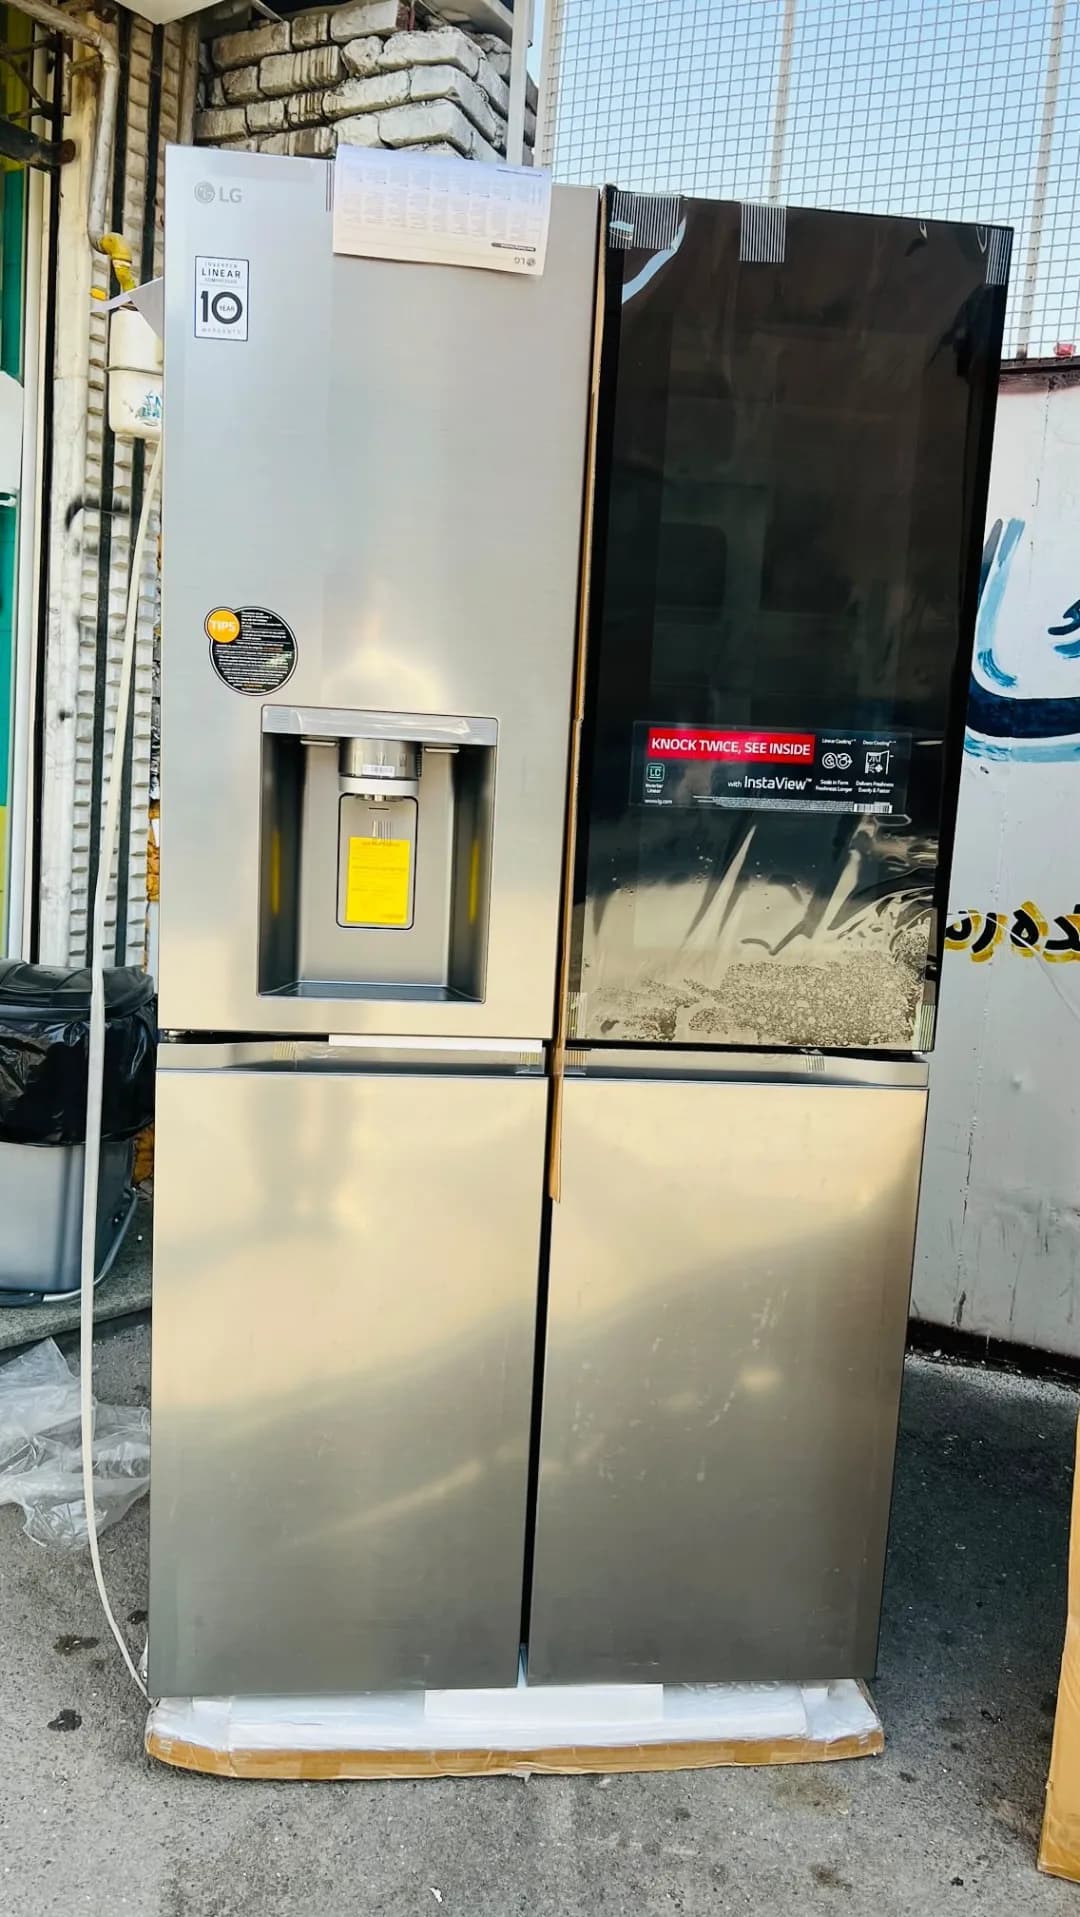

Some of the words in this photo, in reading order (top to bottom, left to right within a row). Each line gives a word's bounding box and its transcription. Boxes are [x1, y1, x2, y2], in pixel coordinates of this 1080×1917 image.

[201, 267, 241, 279] LINEAR
[200, 290, 243, 325] 10
[210, 619, 237, 633] TIPS
[651, 737, 697, 751] KNOCK
[699, 739, 742, 755] TWICE,
[744, 742, 767, 754] SEE
[769, 742, 811, 756] INSIDE
[727, 780, 743, 788] with
